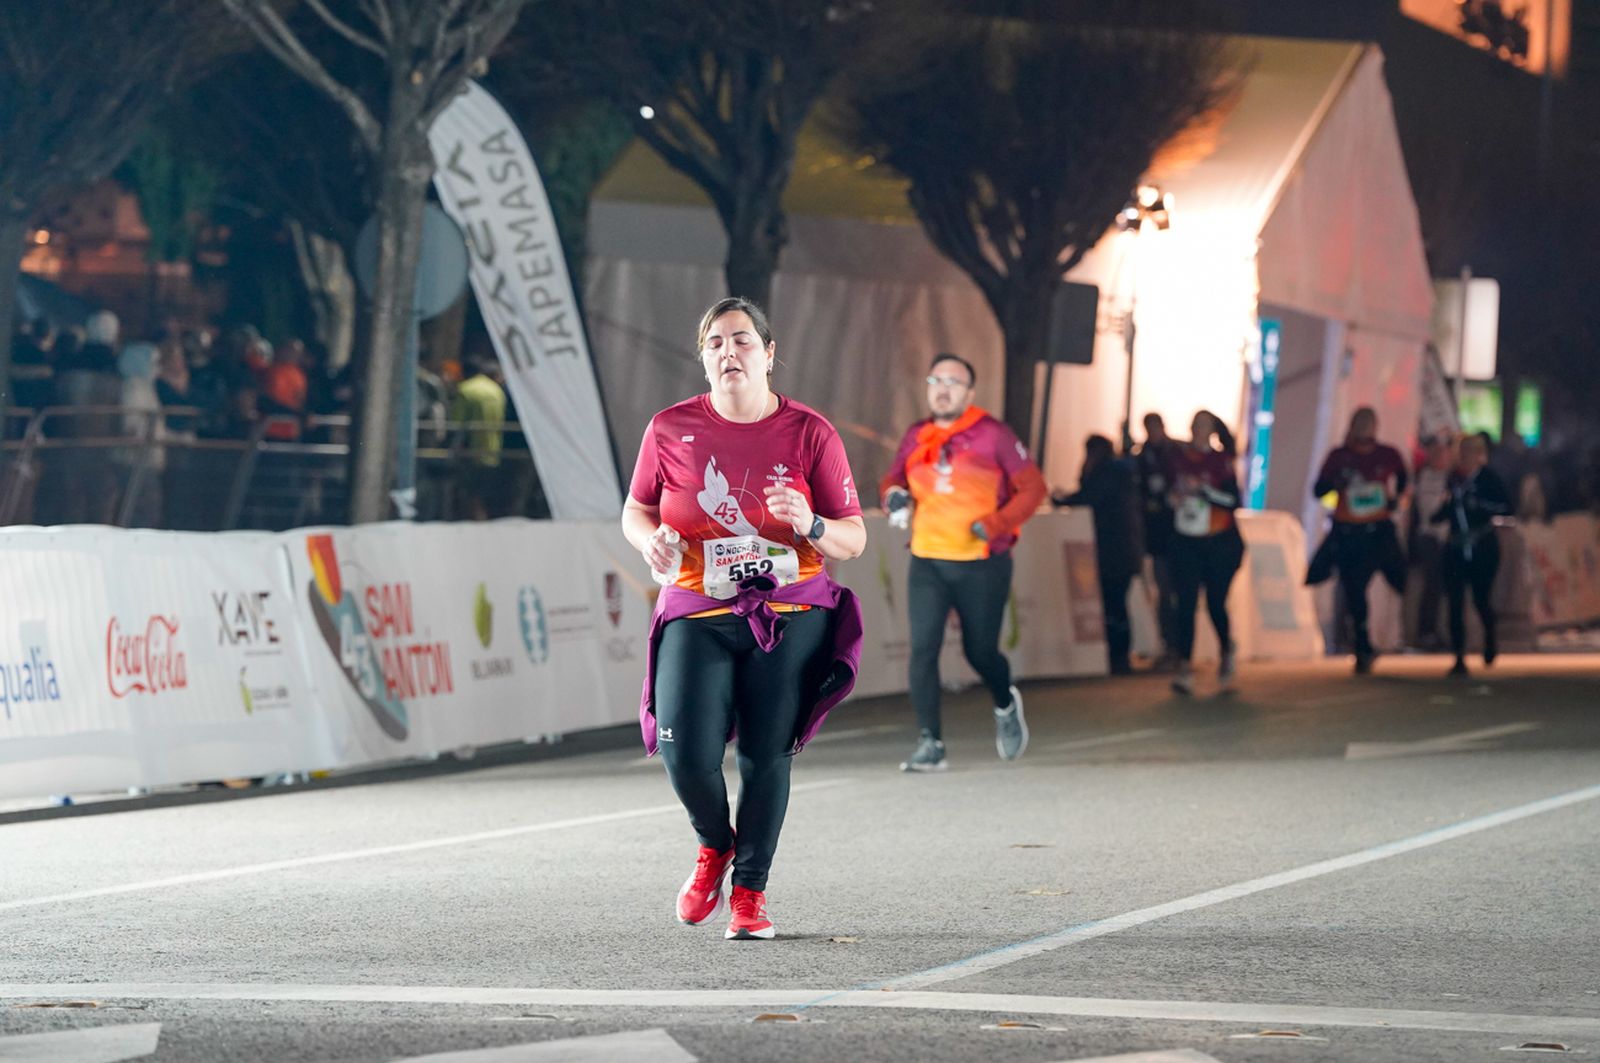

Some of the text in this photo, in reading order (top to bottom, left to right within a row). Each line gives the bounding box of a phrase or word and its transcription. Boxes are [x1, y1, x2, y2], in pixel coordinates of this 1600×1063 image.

[479, 126, 579, 360] JAPEMASA
[714, 501, 738, 525] 43
[715, 557, 733, 567] SAN
[728, 559, 774, 582] 552
[364, 582, 414, 638] SAN
